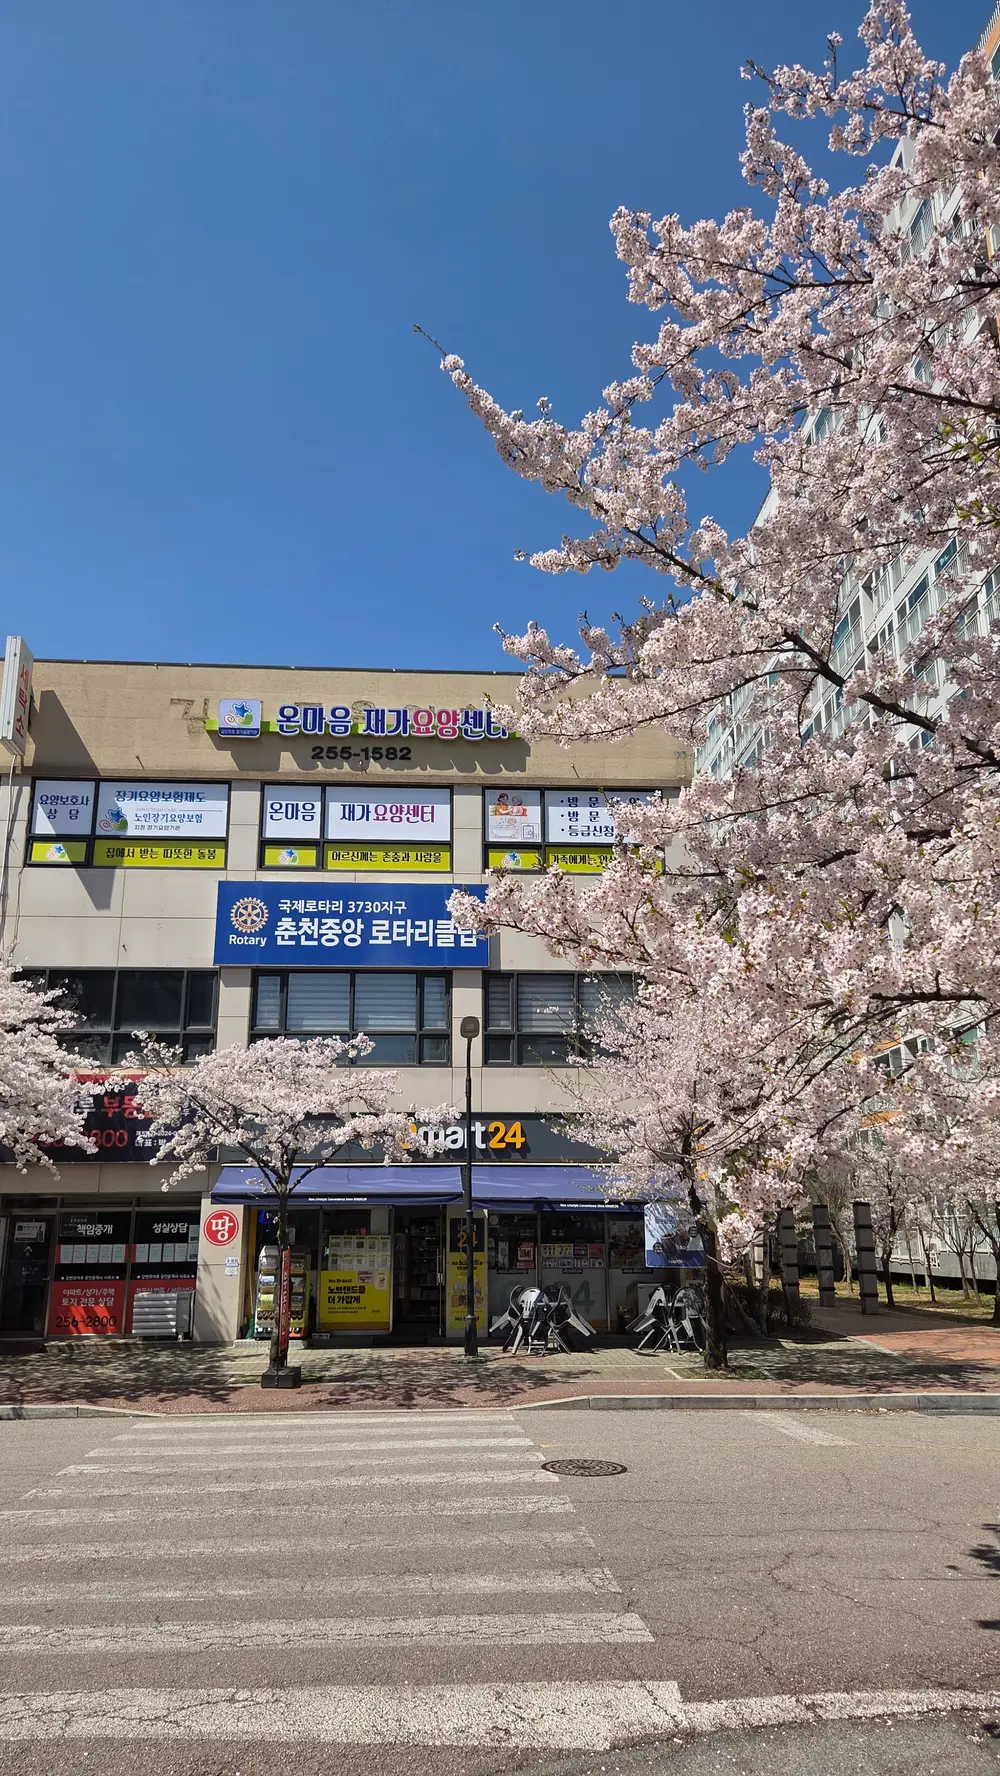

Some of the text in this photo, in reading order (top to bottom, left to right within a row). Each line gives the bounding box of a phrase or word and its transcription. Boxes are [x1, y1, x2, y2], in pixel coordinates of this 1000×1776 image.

[277, 705, 509, 739] 온마음 재가요양센터
[311, 745, 412, 760] 255-1582
[40, 794, 90, 806] 요양보호사
[115, 790, 207, 803] 장기요양보험제도
[268, 801, 316, 822] 온마음
[134, 813, 203, 824] 노인장기요양보험
[106, 847, 135, 859] 집에서
[139, 848, 159, 859] 받는
[163, 848, 193, 860] 따뜻한
[331, 851, 442, 864] 어르신께는 존중과 사랑을
[550, 854, 597, 865] 가족에게는
[278, 899, 407, 915] 국제로타리 3730지구
[274, 917, 364, 947] 춘천중앙
[229, 934, 267, 947] Rotary
[76, 1222, 189, 1236] 책임중개 성실상담
[211, 1216, 234, 1241] 땅
[61, 1297, 77, 1306] 토지
[98, 1297, 115, 1307] 상담
[327, 1295, 361, 1304] 더 가깝게
[56, 1315, 117, 1328] 256-2800
